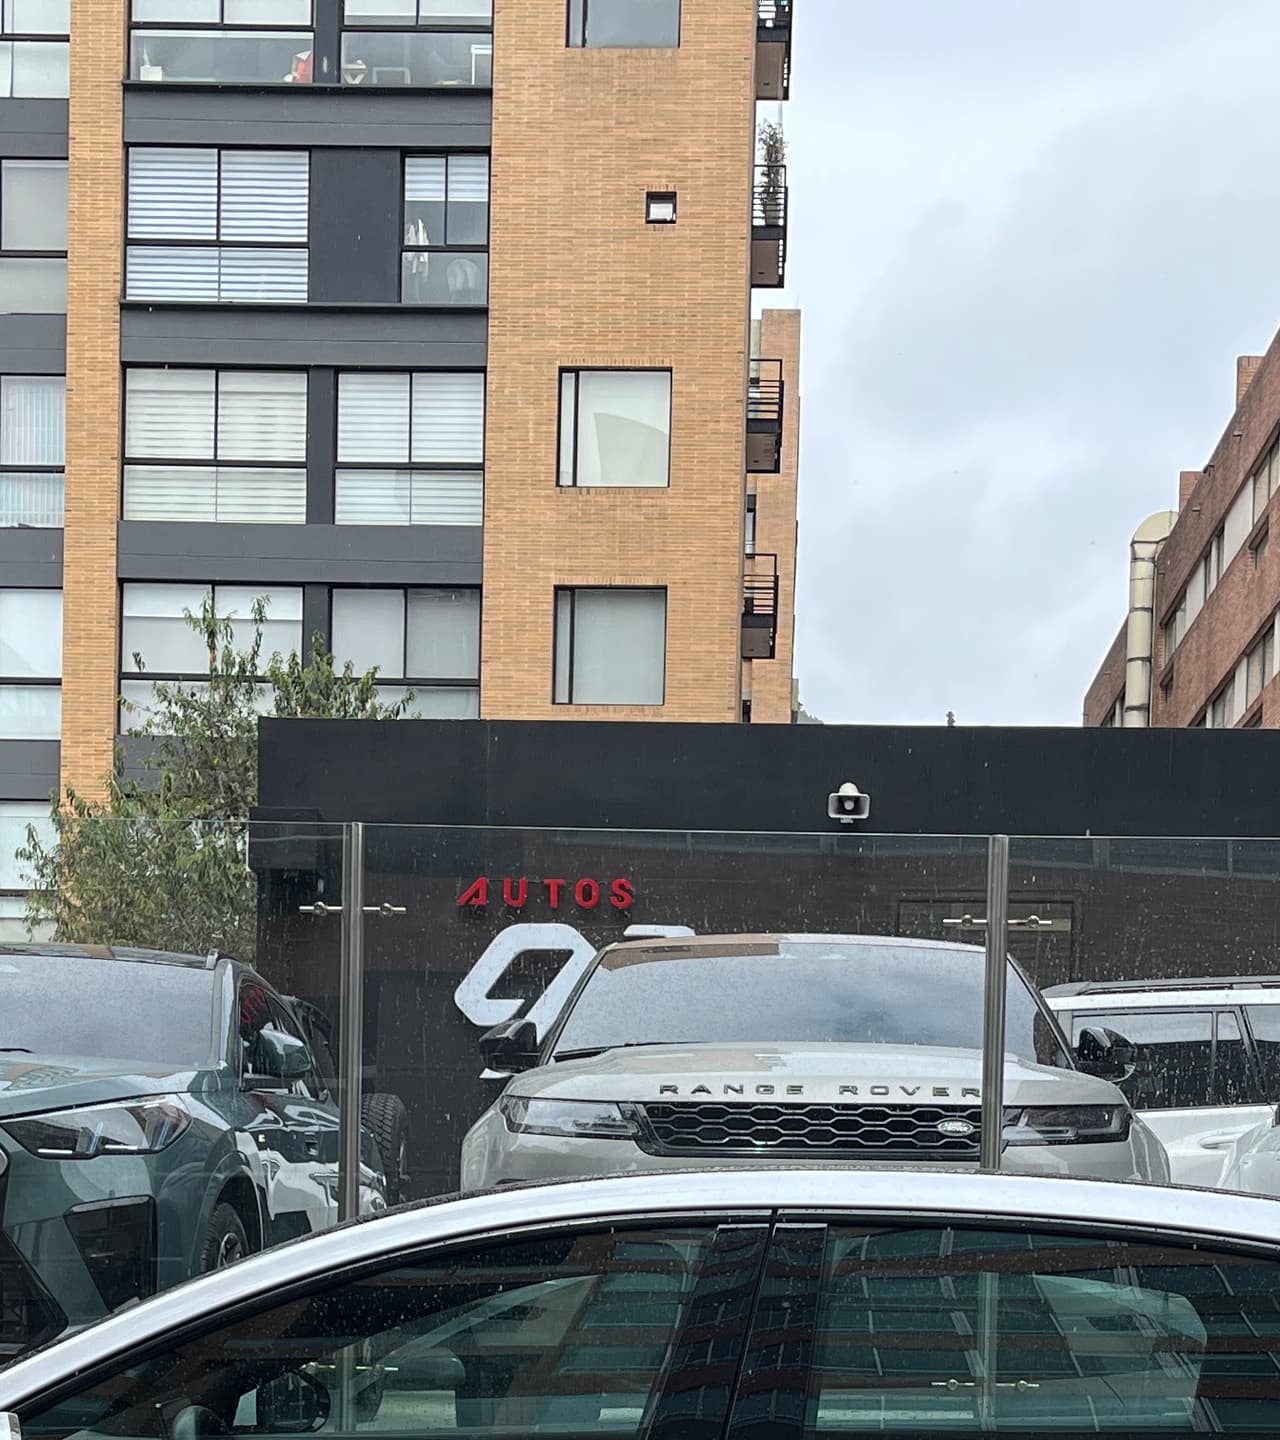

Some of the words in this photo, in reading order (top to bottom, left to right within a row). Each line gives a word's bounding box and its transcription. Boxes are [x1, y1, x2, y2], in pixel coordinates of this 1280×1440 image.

[457, 877, 634, 909] AUTOS
[659, 1084, 805, 1096] RANGE
[838, 1085, 981, 1098] ROVER
